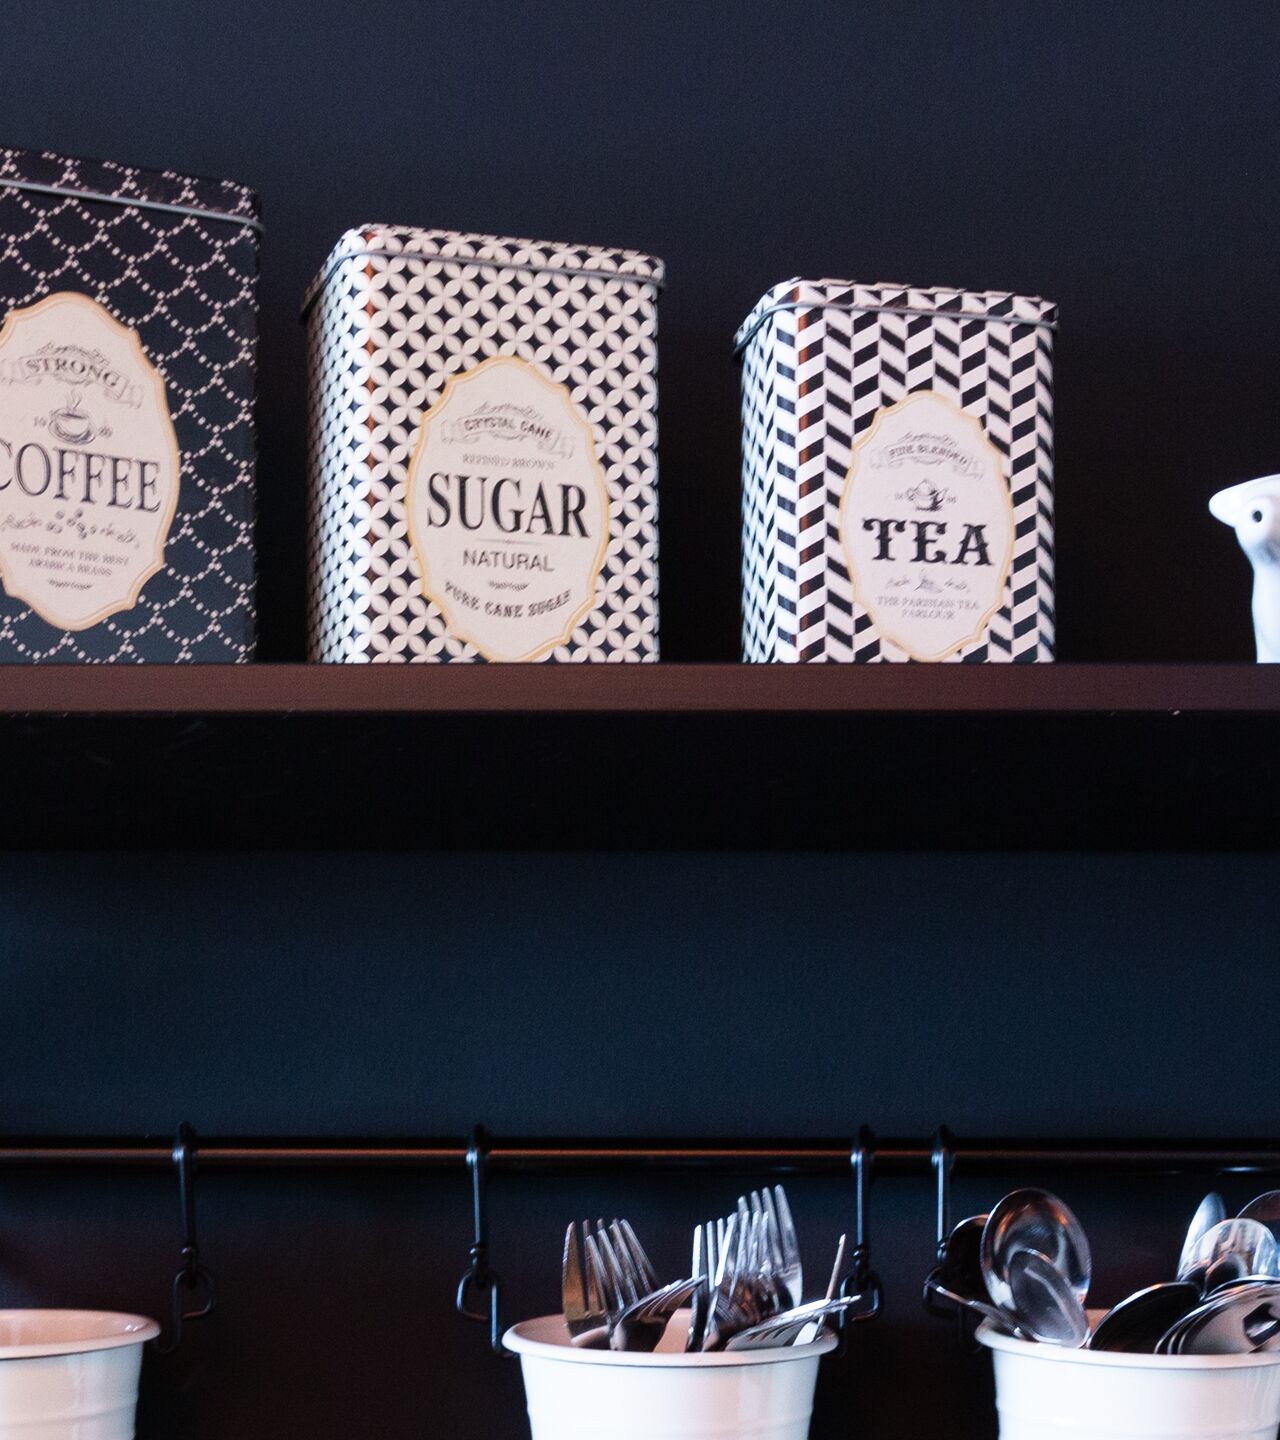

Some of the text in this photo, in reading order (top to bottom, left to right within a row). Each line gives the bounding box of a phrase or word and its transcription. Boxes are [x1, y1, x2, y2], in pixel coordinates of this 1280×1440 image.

[26, 358, 120, 387] STRONG
[463, 416, 553, 439] CRYSTAL CANE
[427, 472, 591, 538] SUGAR
[863, 518, 993, 566] TEA
[463, 549, 556, 572] NATURAL
[445, 580, 480, 611] PURE
[484, 601, 524, 618] CANE
[527, 589, 572, 617] SUGAR
